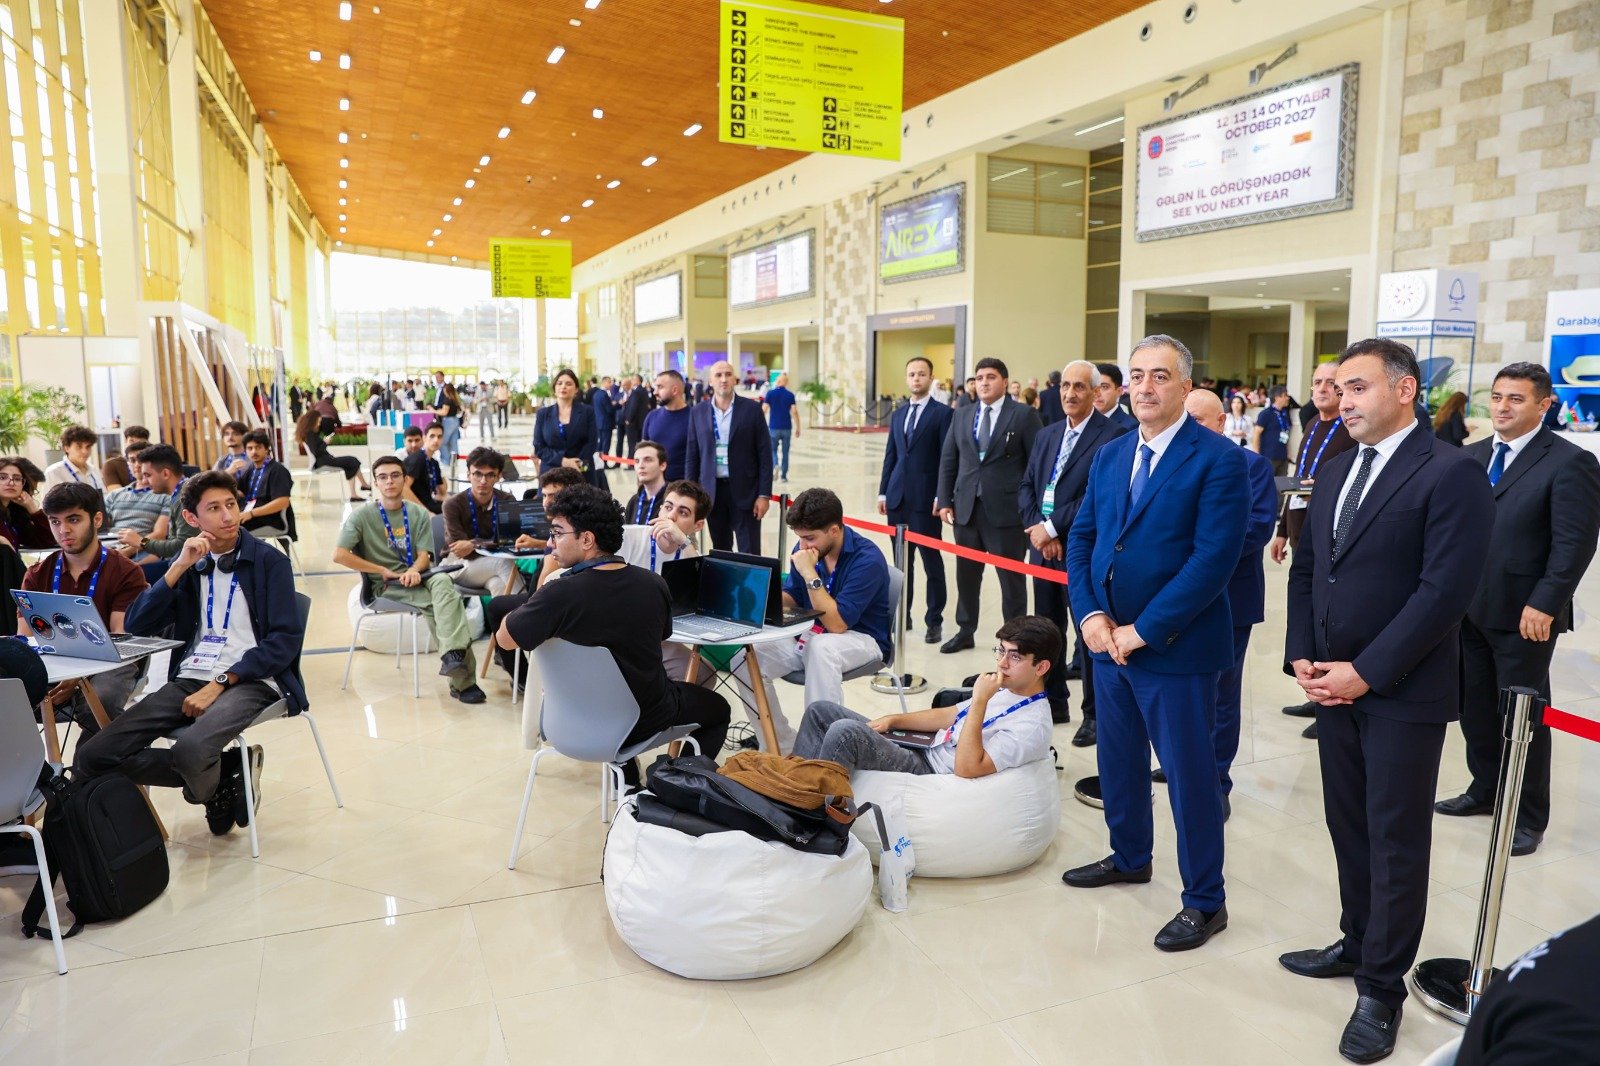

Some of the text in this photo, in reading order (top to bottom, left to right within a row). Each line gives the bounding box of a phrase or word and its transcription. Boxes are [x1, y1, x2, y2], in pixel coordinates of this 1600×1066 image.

[1216, 88, 1331, 129] 12 13 14 OKTYABR
[1225, 116, 1281, 140] OCTOBER
[1284, 107, 1316, 125] 2027
[1156, 166, 1312, 208] GƏLƏN İL GÖRÜŞƏNƏDƏK
[1172, 188, 1290, 219] SEE YOU NEXT YEAR
